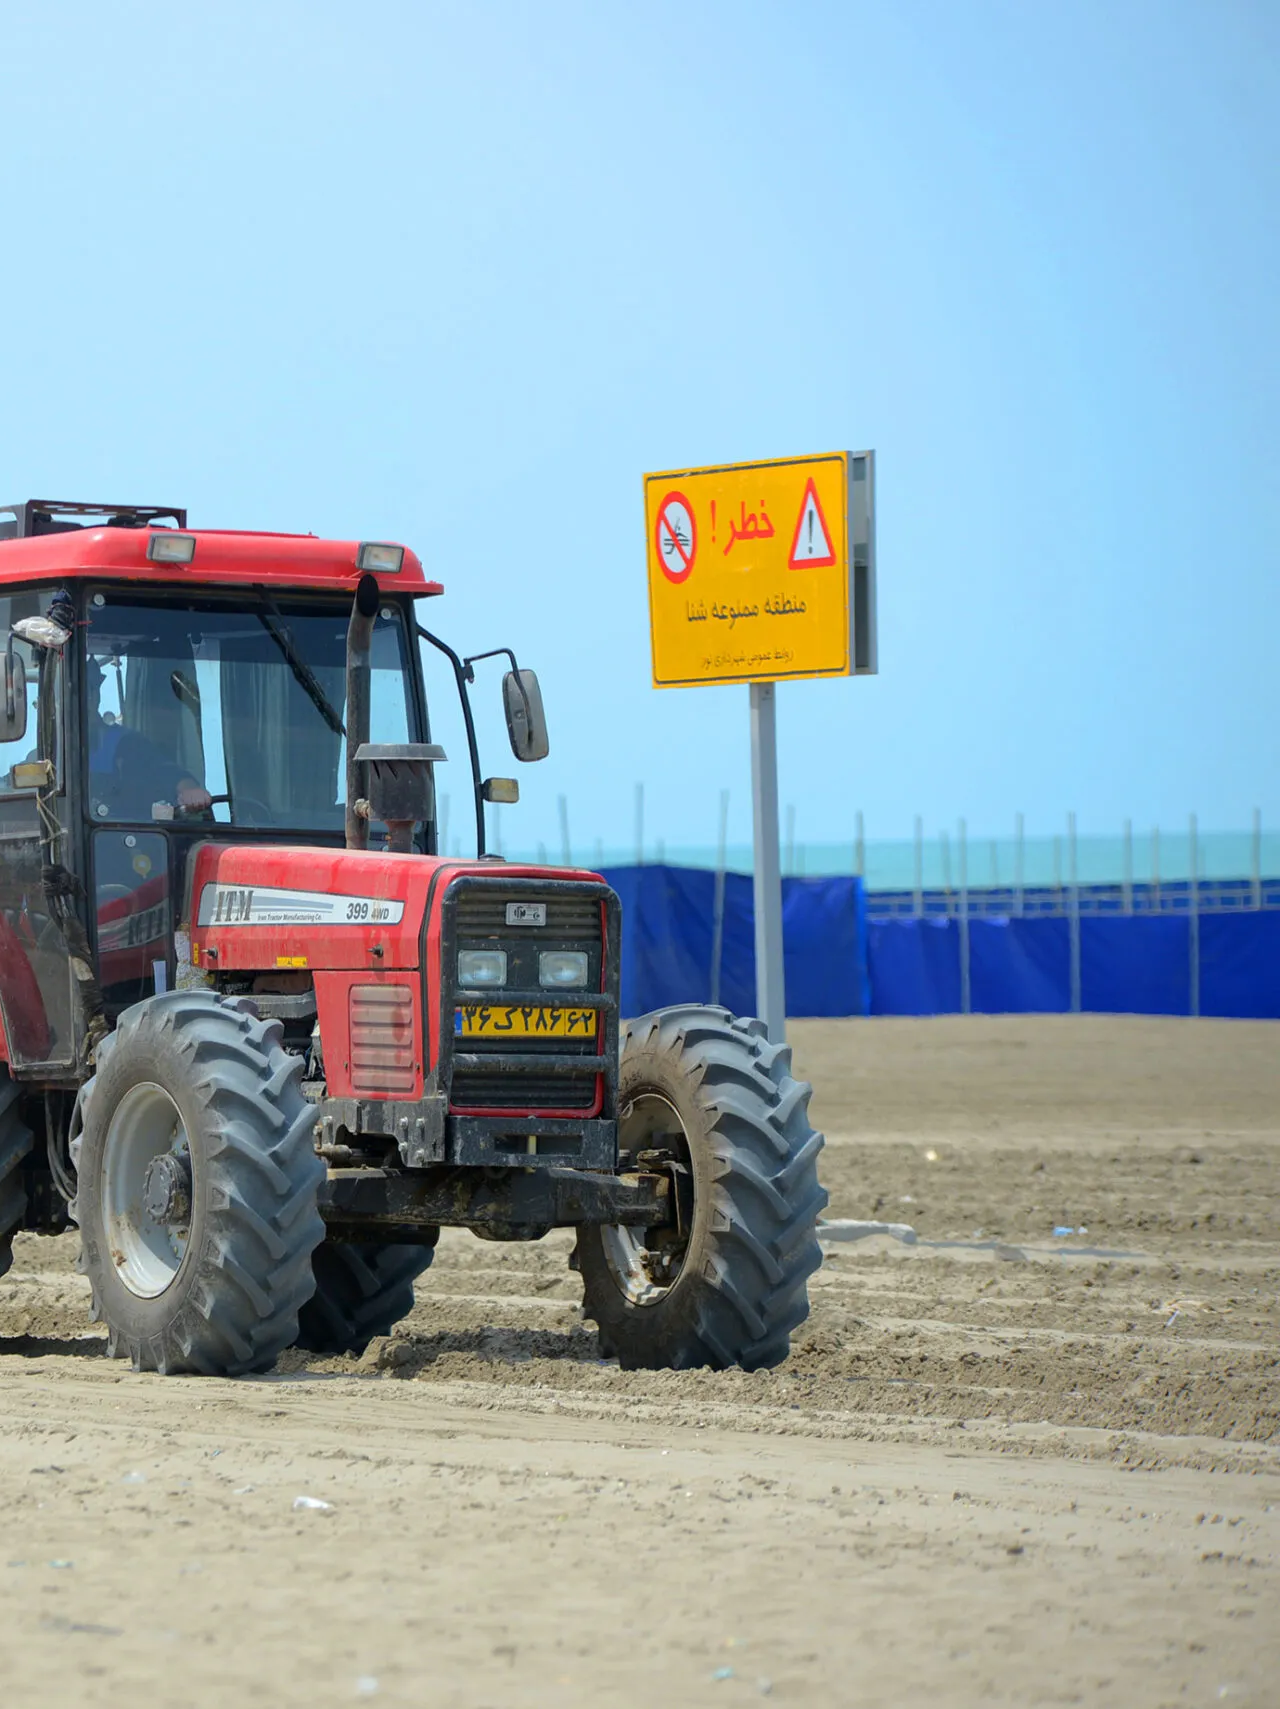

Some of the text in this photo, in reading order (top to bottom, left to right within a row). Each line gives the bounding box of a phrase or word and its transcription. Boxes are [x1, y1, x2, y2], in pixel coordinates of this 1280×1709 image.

[686, 592, 807, 630] منطقه ممنوعه شنا
[214, 890, 254, 922] ITM
[346, 902, 390, 920] 399 4WD
